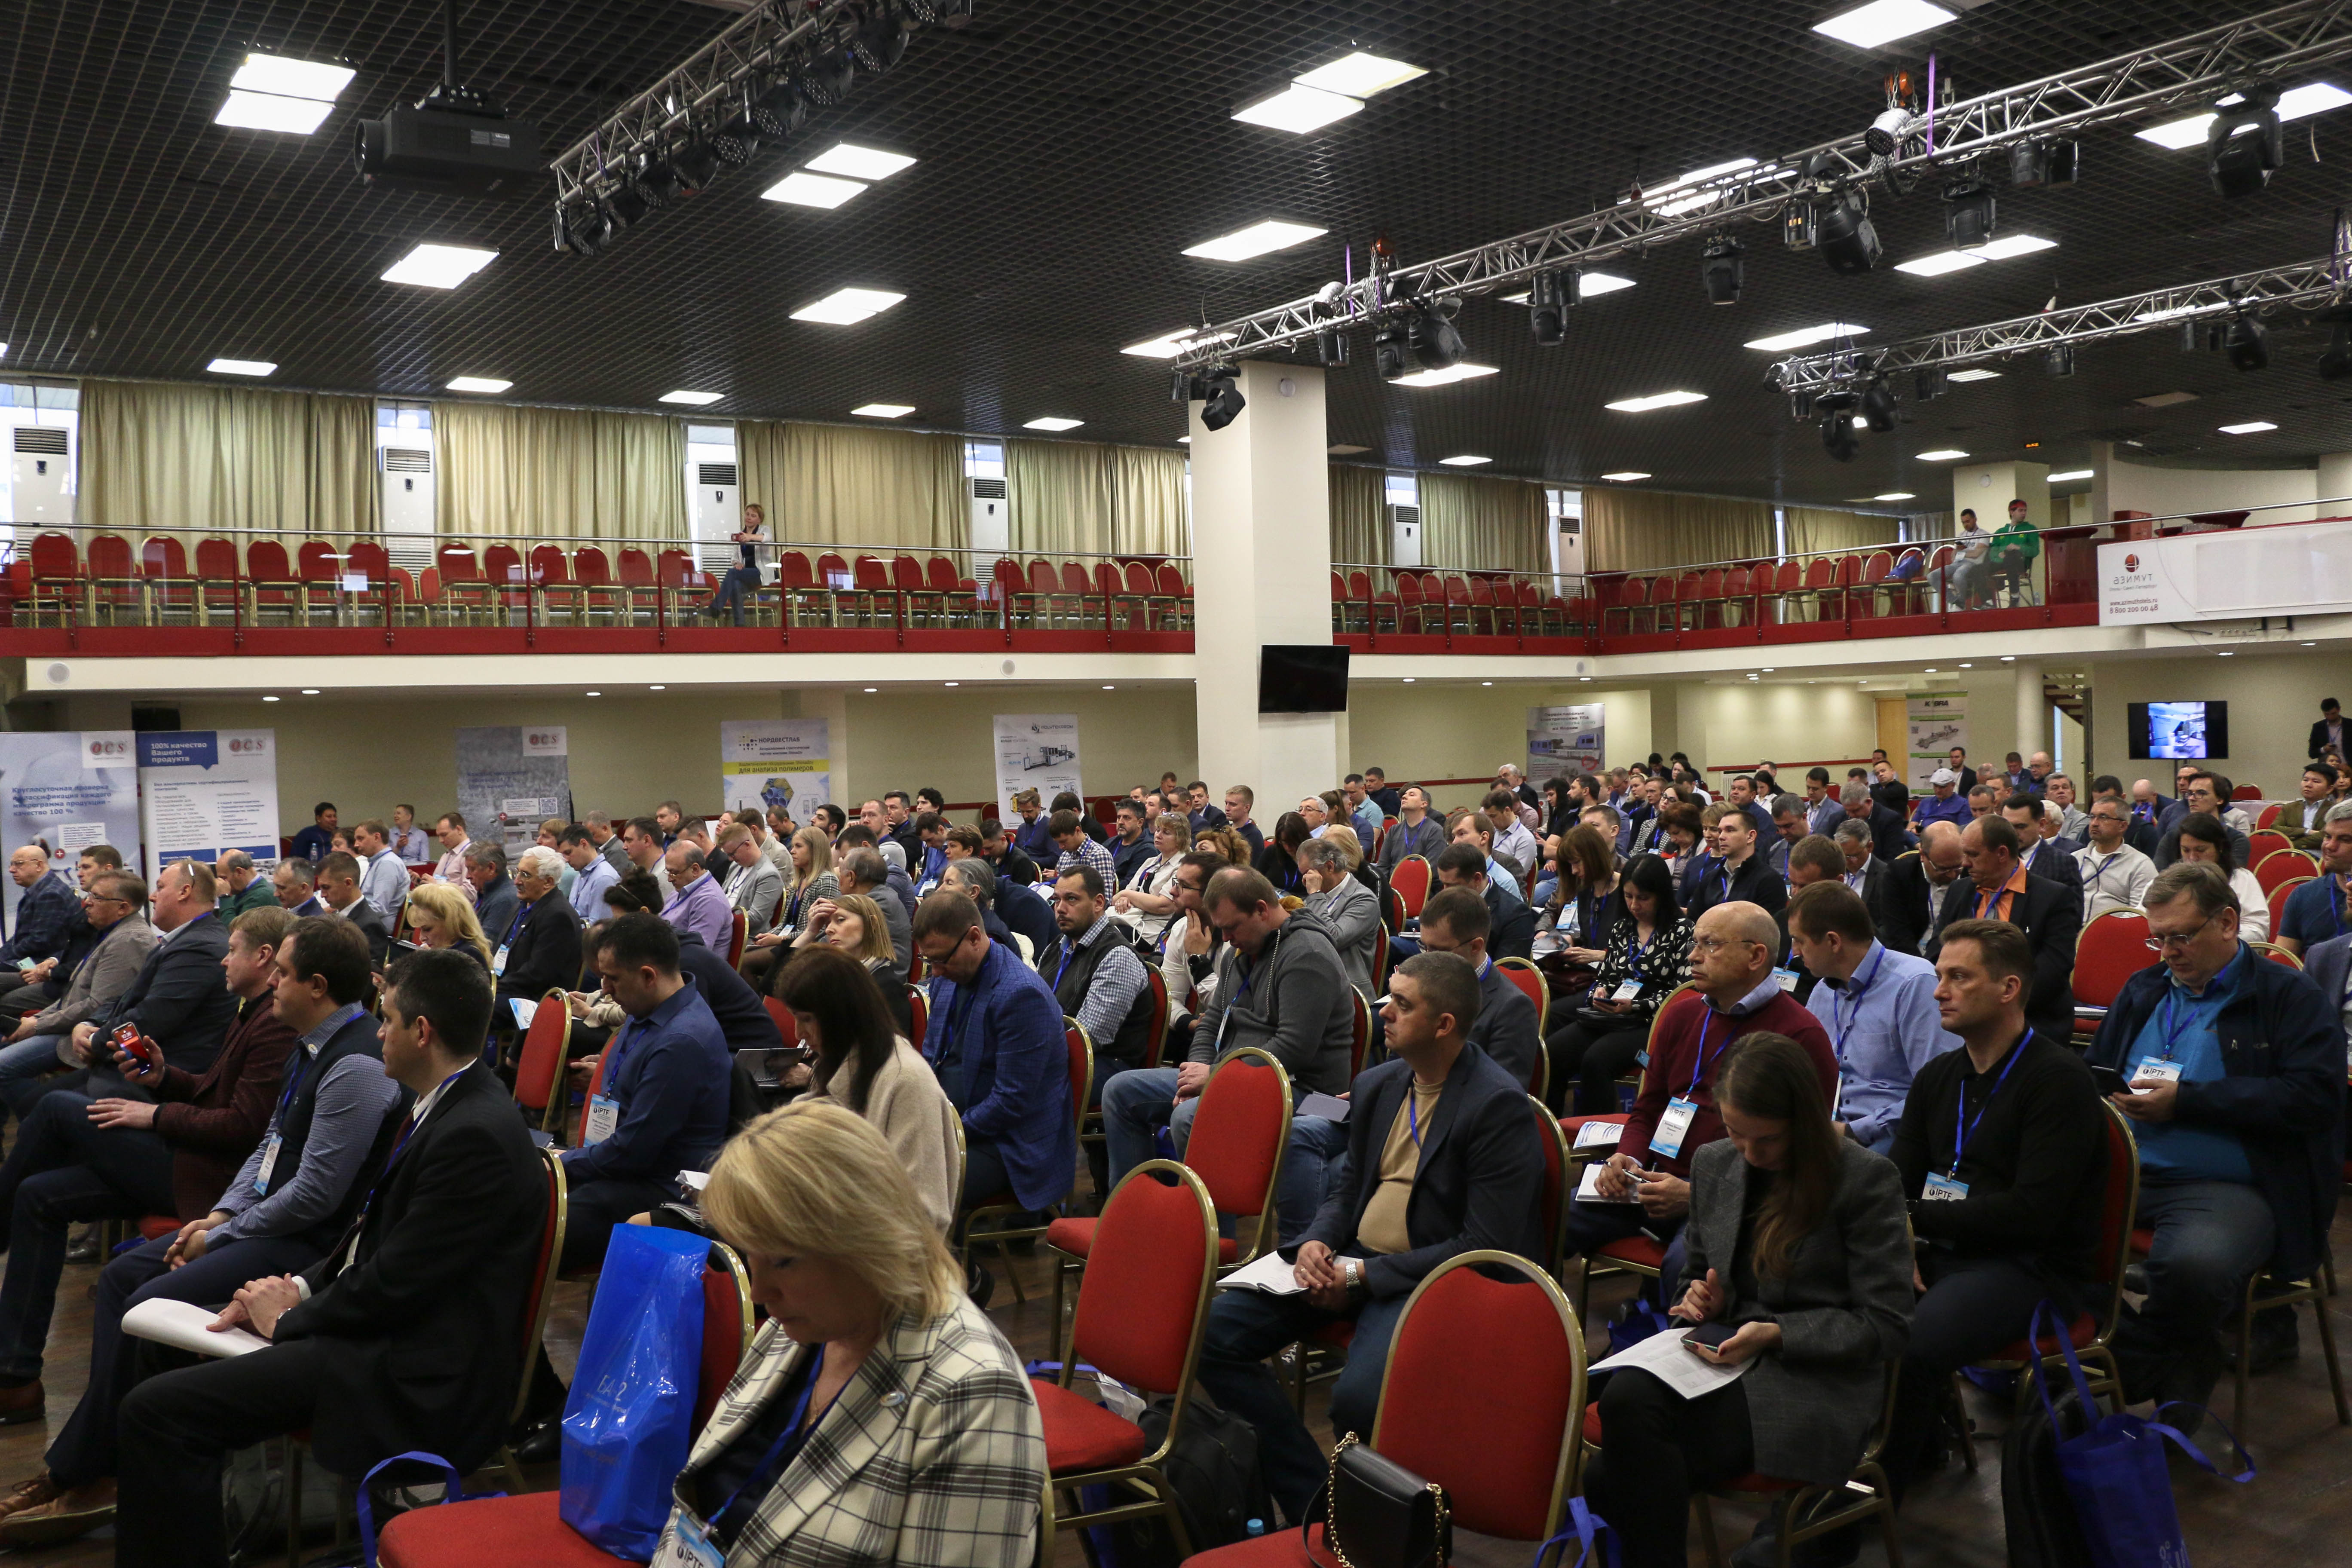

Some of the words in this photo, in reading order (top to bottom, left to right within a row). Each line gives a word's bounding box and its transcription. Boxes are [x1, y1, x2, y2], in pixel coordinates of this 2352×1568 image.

[91, 741, 126, 755] OCS
[230, 739, 264, 751] OCS
[2149, 1068, 2166, 1077] IPTF
[598, 1107, 609, 1115] IPTF
[1935, 1188, 1952, 1200] IPTF
